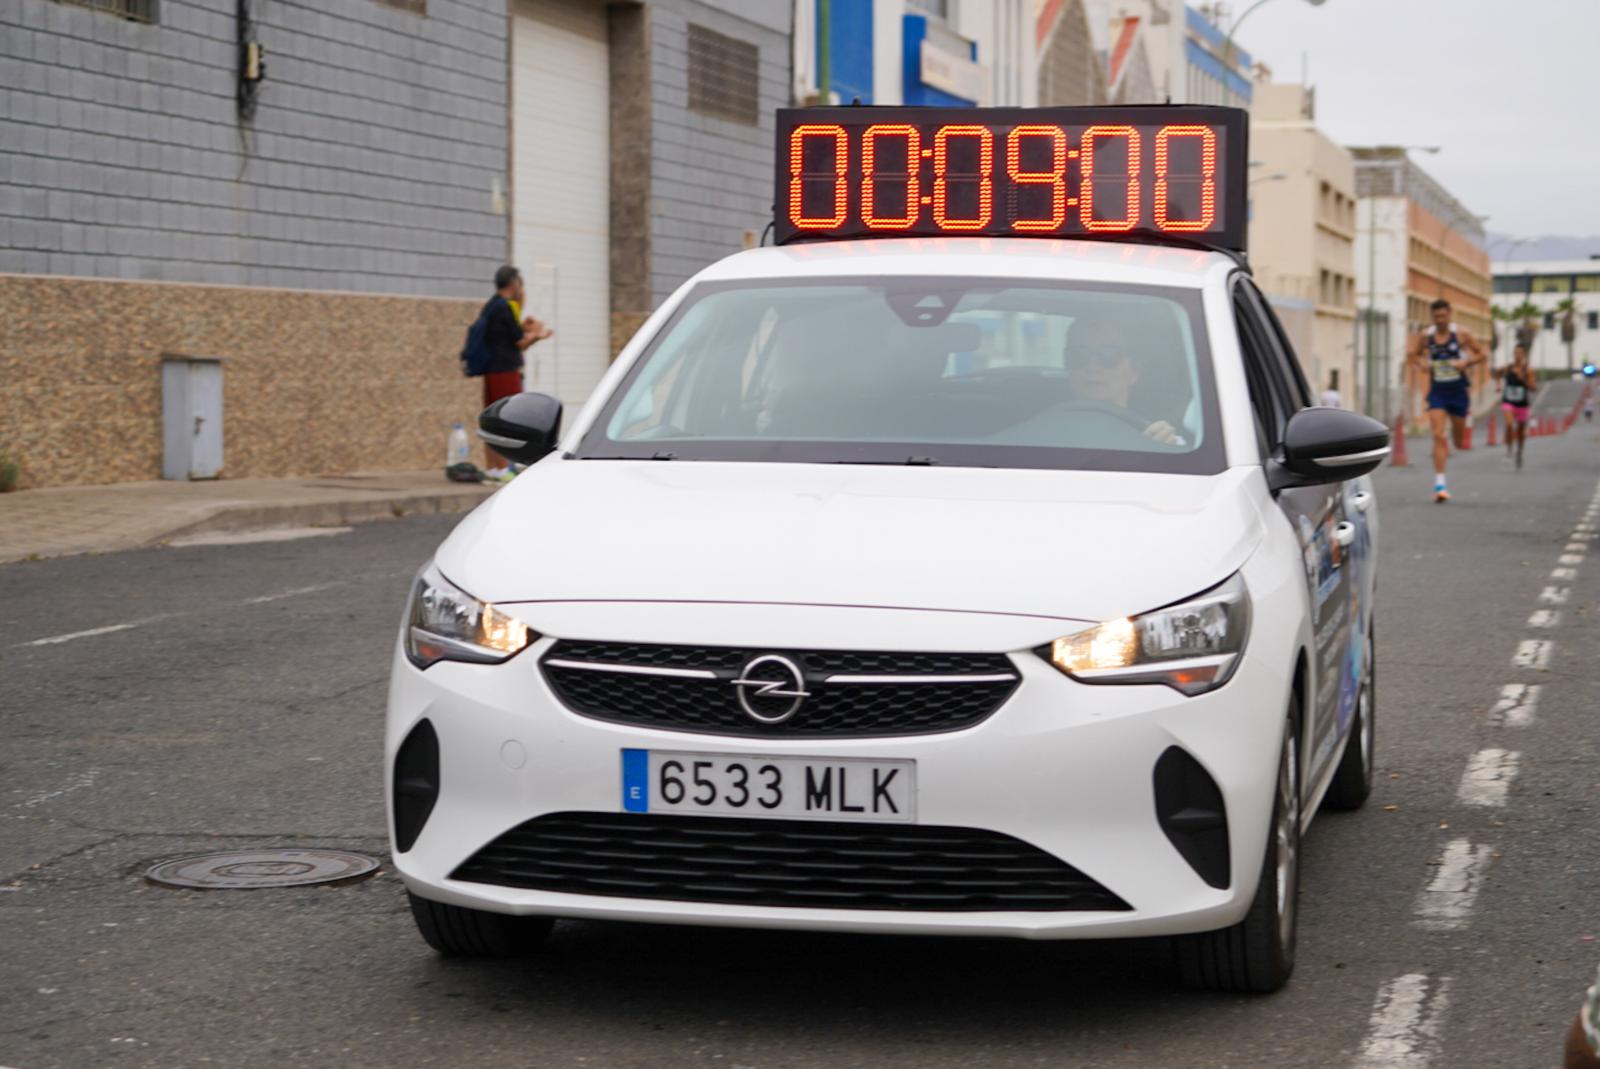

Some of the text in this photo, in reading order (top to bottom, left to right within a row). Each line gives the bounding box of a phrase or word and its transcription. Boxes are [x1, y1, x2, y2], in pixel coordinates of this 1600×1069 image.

[789, 124, 1217, 232] 00:09:00
[630, 786, 641, 800] E
[660, 759, 900, 814] 6533 MLK
